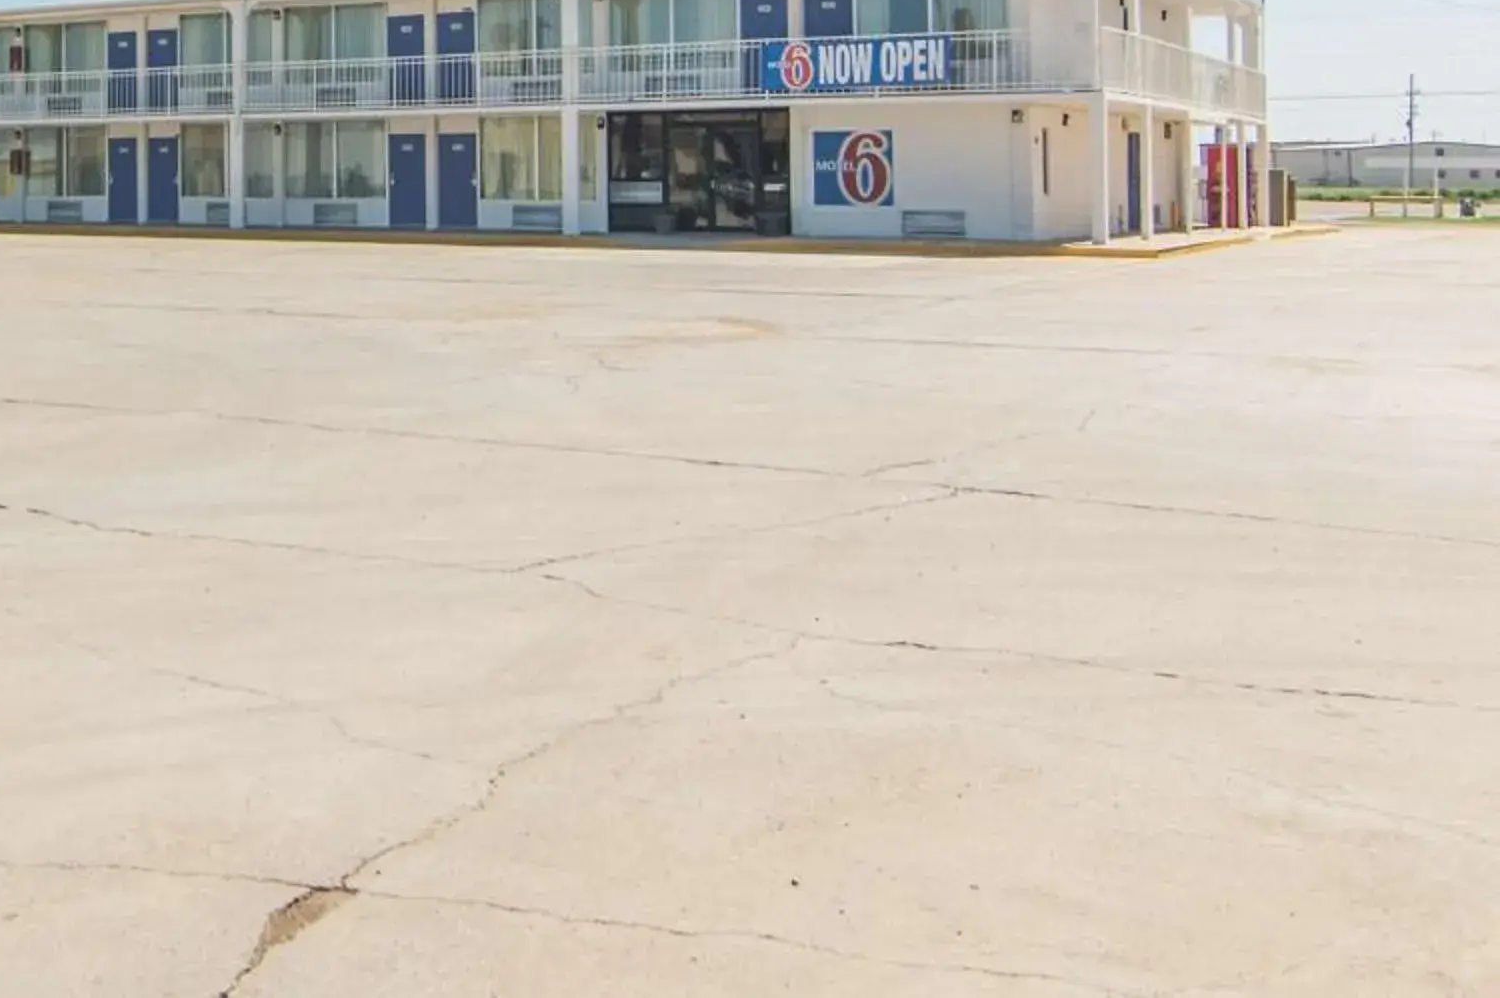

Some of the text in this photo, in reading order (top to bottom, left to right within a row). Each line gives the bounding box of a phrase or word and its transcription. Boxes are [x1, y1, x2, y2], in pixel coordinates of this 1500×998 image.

[782, 38, 945, 88] 6 NOW OPEN
[815, 132, 888, 204] MOEL 6
